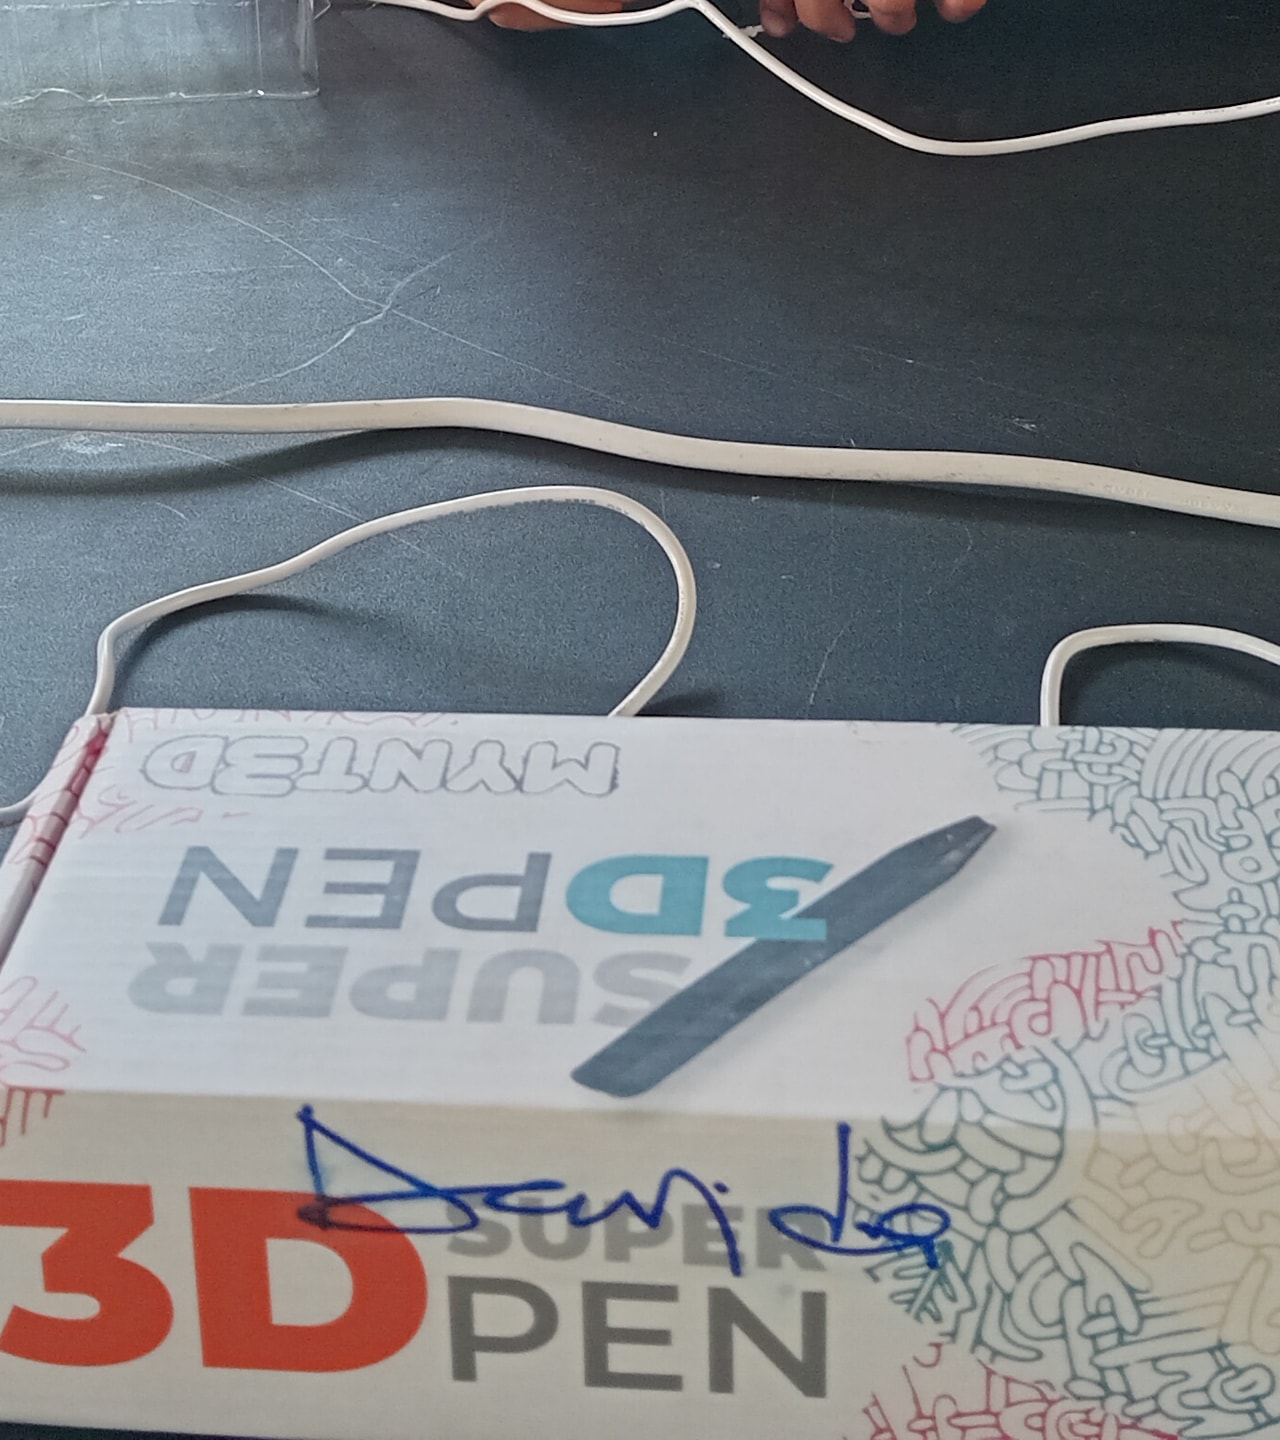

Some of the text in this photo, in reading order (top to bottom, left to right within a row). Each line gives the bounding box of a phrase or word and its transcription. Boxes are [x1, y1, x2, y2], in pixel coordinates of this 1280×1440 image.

[137, 732, 622, 799] MYNT3D
[126, 940, 694, 1029] SUPER
[446, 1195, 827, 1271] SUPER
[446, 1274, 828, 1399] PEN
